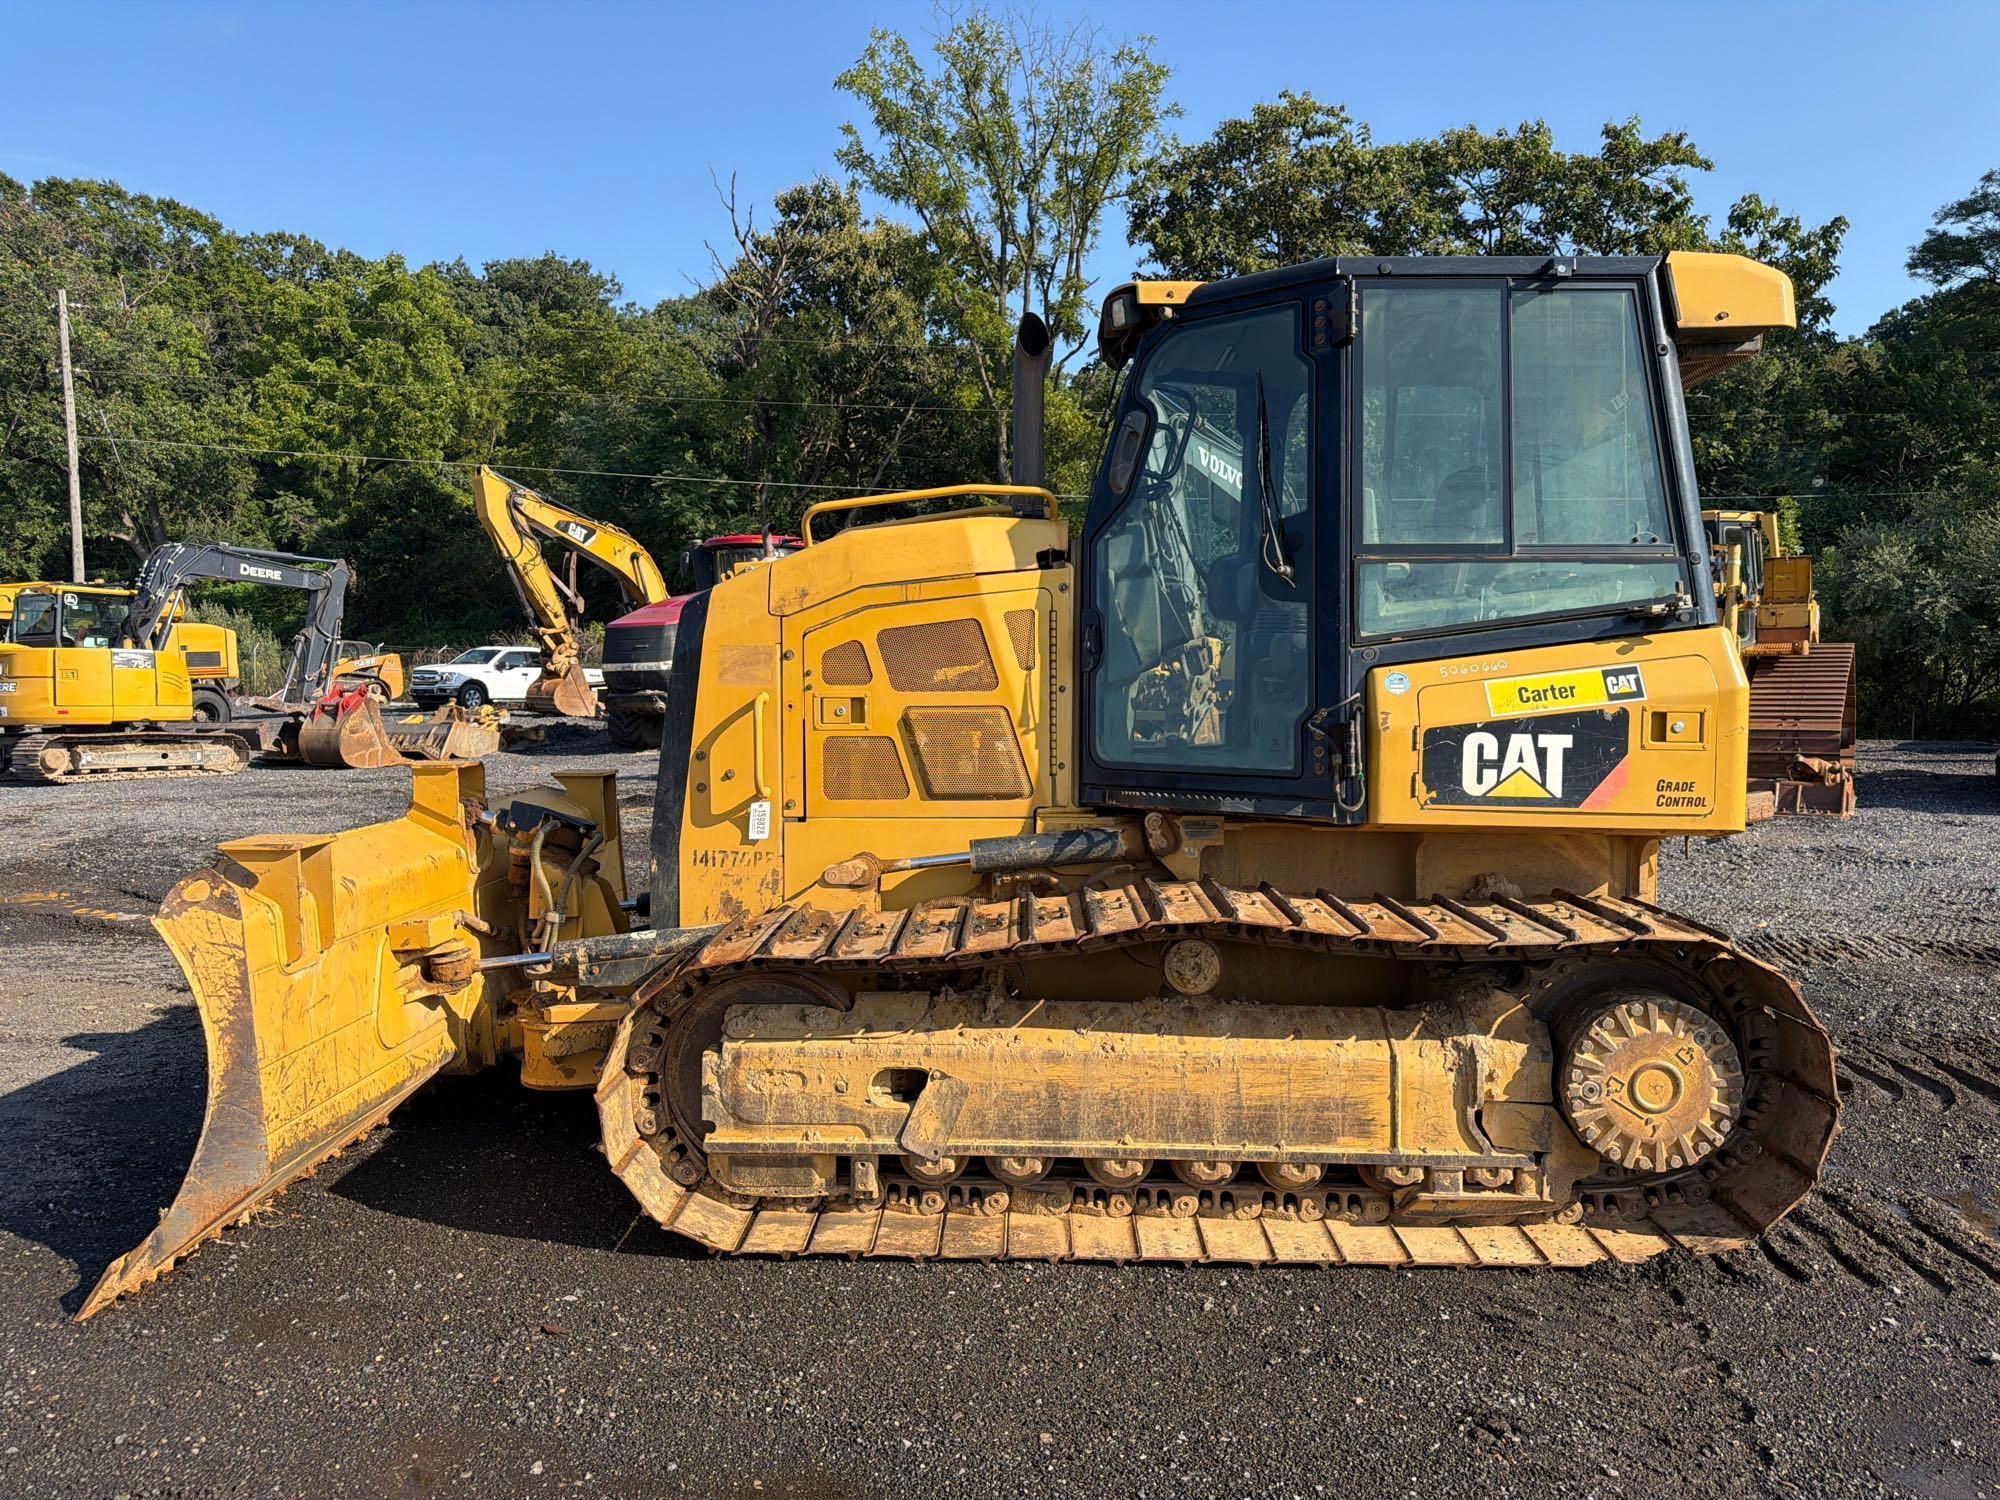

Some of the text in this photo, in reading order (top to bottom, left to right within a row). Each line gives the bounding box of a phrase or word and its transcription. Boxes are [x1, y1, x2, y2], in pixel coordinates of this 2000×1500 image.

[1198, 446, 1243, 490] VOLVO
[567, 522, 588, 542] CAT
[240, 563, 282, 580] DEERE
[1517, 674, 1638, 704] Carter CAT
[1462, 731, 1573, 799] CAT
[1656, 779, 1696, 793] GRADE
[1655, 794, 1708, 808] CONTROL
